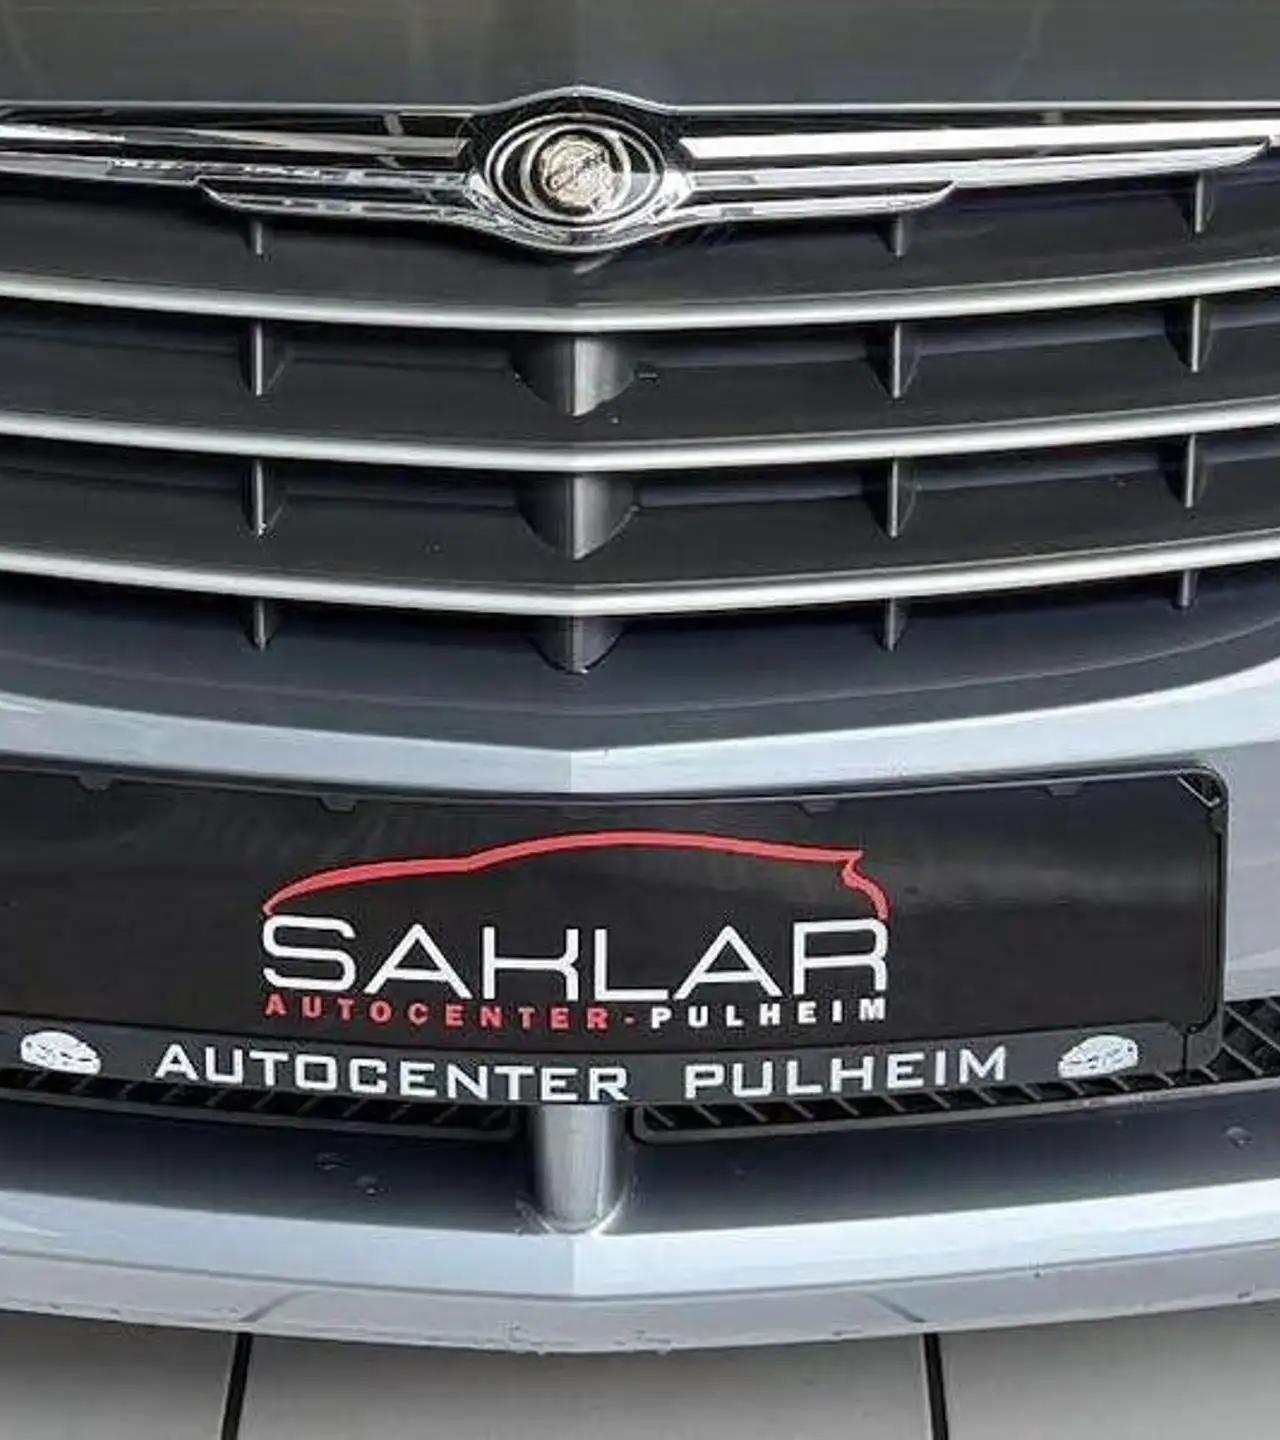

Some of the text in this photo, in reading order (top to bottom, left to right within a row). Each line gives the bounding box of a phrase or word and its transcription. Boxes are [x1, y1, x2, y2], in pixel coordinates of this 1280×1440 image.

[263, 914, 888, 1002] SAHLAR
[154, 1042, 1008, 1104] AUTOCENTER PULHEIM
